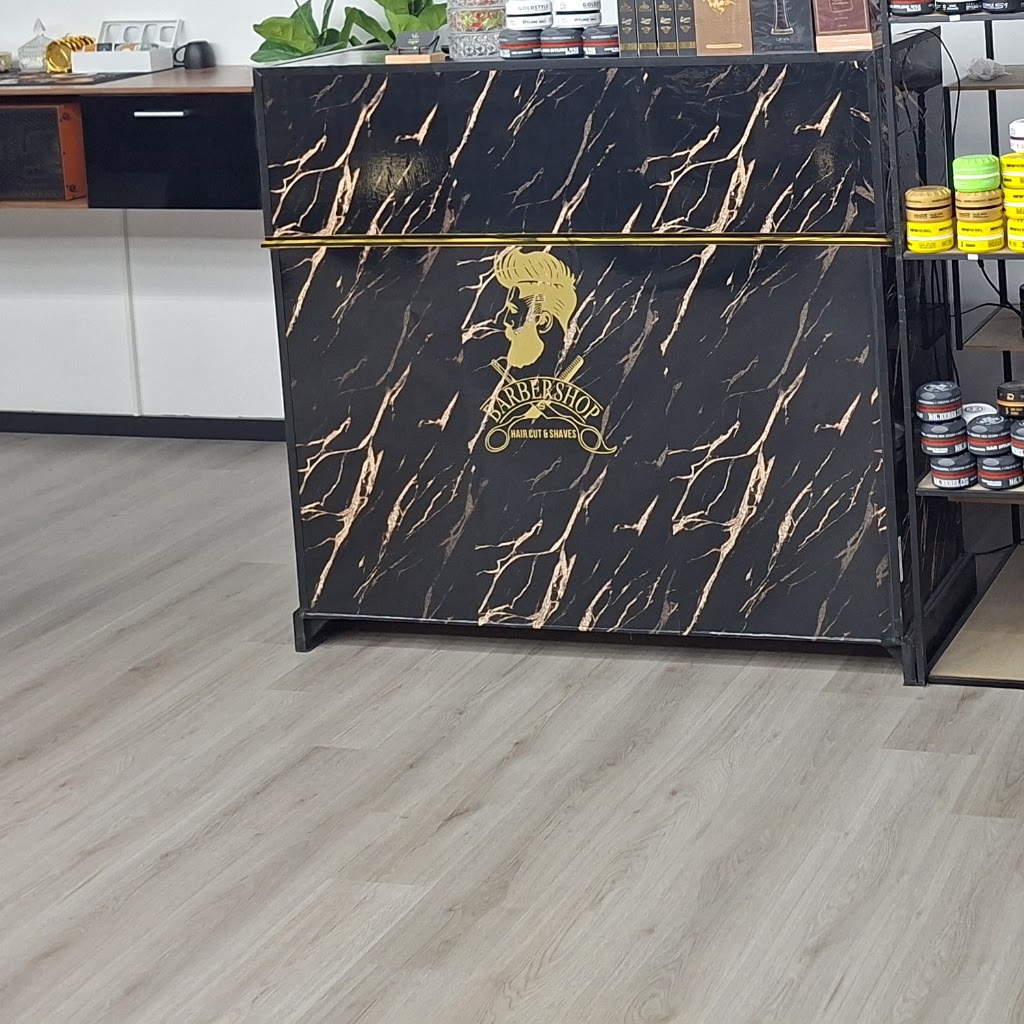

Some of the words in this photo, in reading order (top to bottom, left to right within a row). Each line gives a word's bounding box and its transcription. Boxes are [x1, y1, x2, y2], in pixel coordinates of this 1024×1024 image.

[481, 379, 601, 423] BARBERSHOP
[510, 429, 528, 439] HAIR
[528, 429, 542, 439] CUT
[543, 429, 549, 439] &
[549, 429, 577, 439] SHAVES
